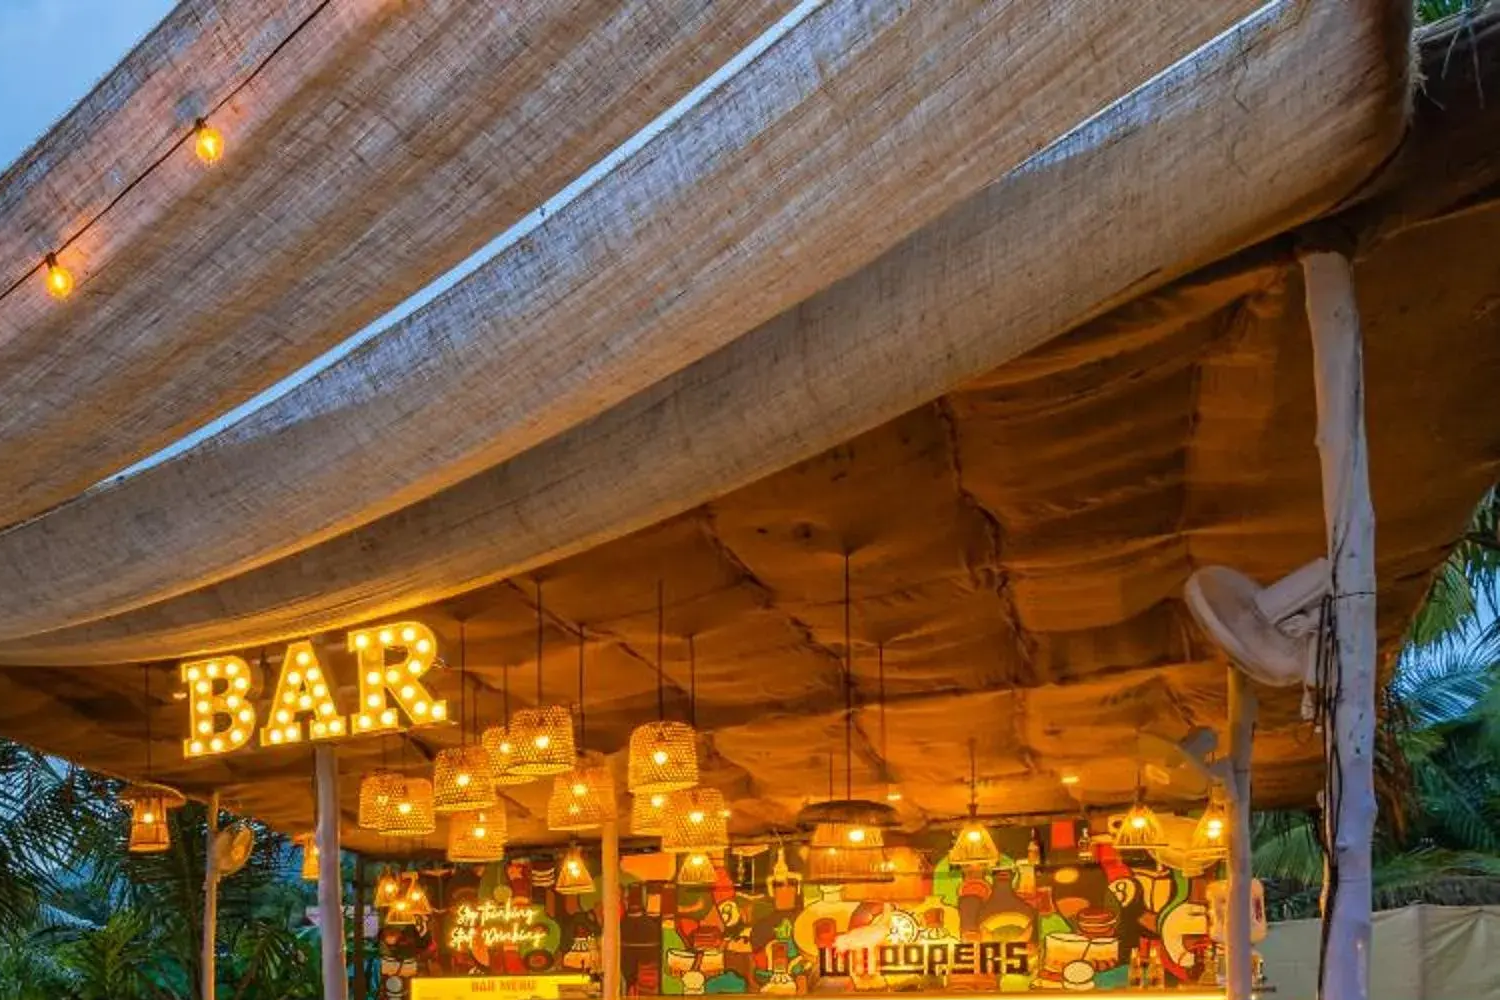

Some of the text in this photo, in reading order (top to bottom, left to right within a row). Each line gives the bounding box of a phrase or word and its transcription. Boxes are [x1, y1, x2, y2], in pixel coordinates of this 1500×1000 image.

[181, 620, 448, 759] BAR
[471, 978, 536, 993] BAR MENU
